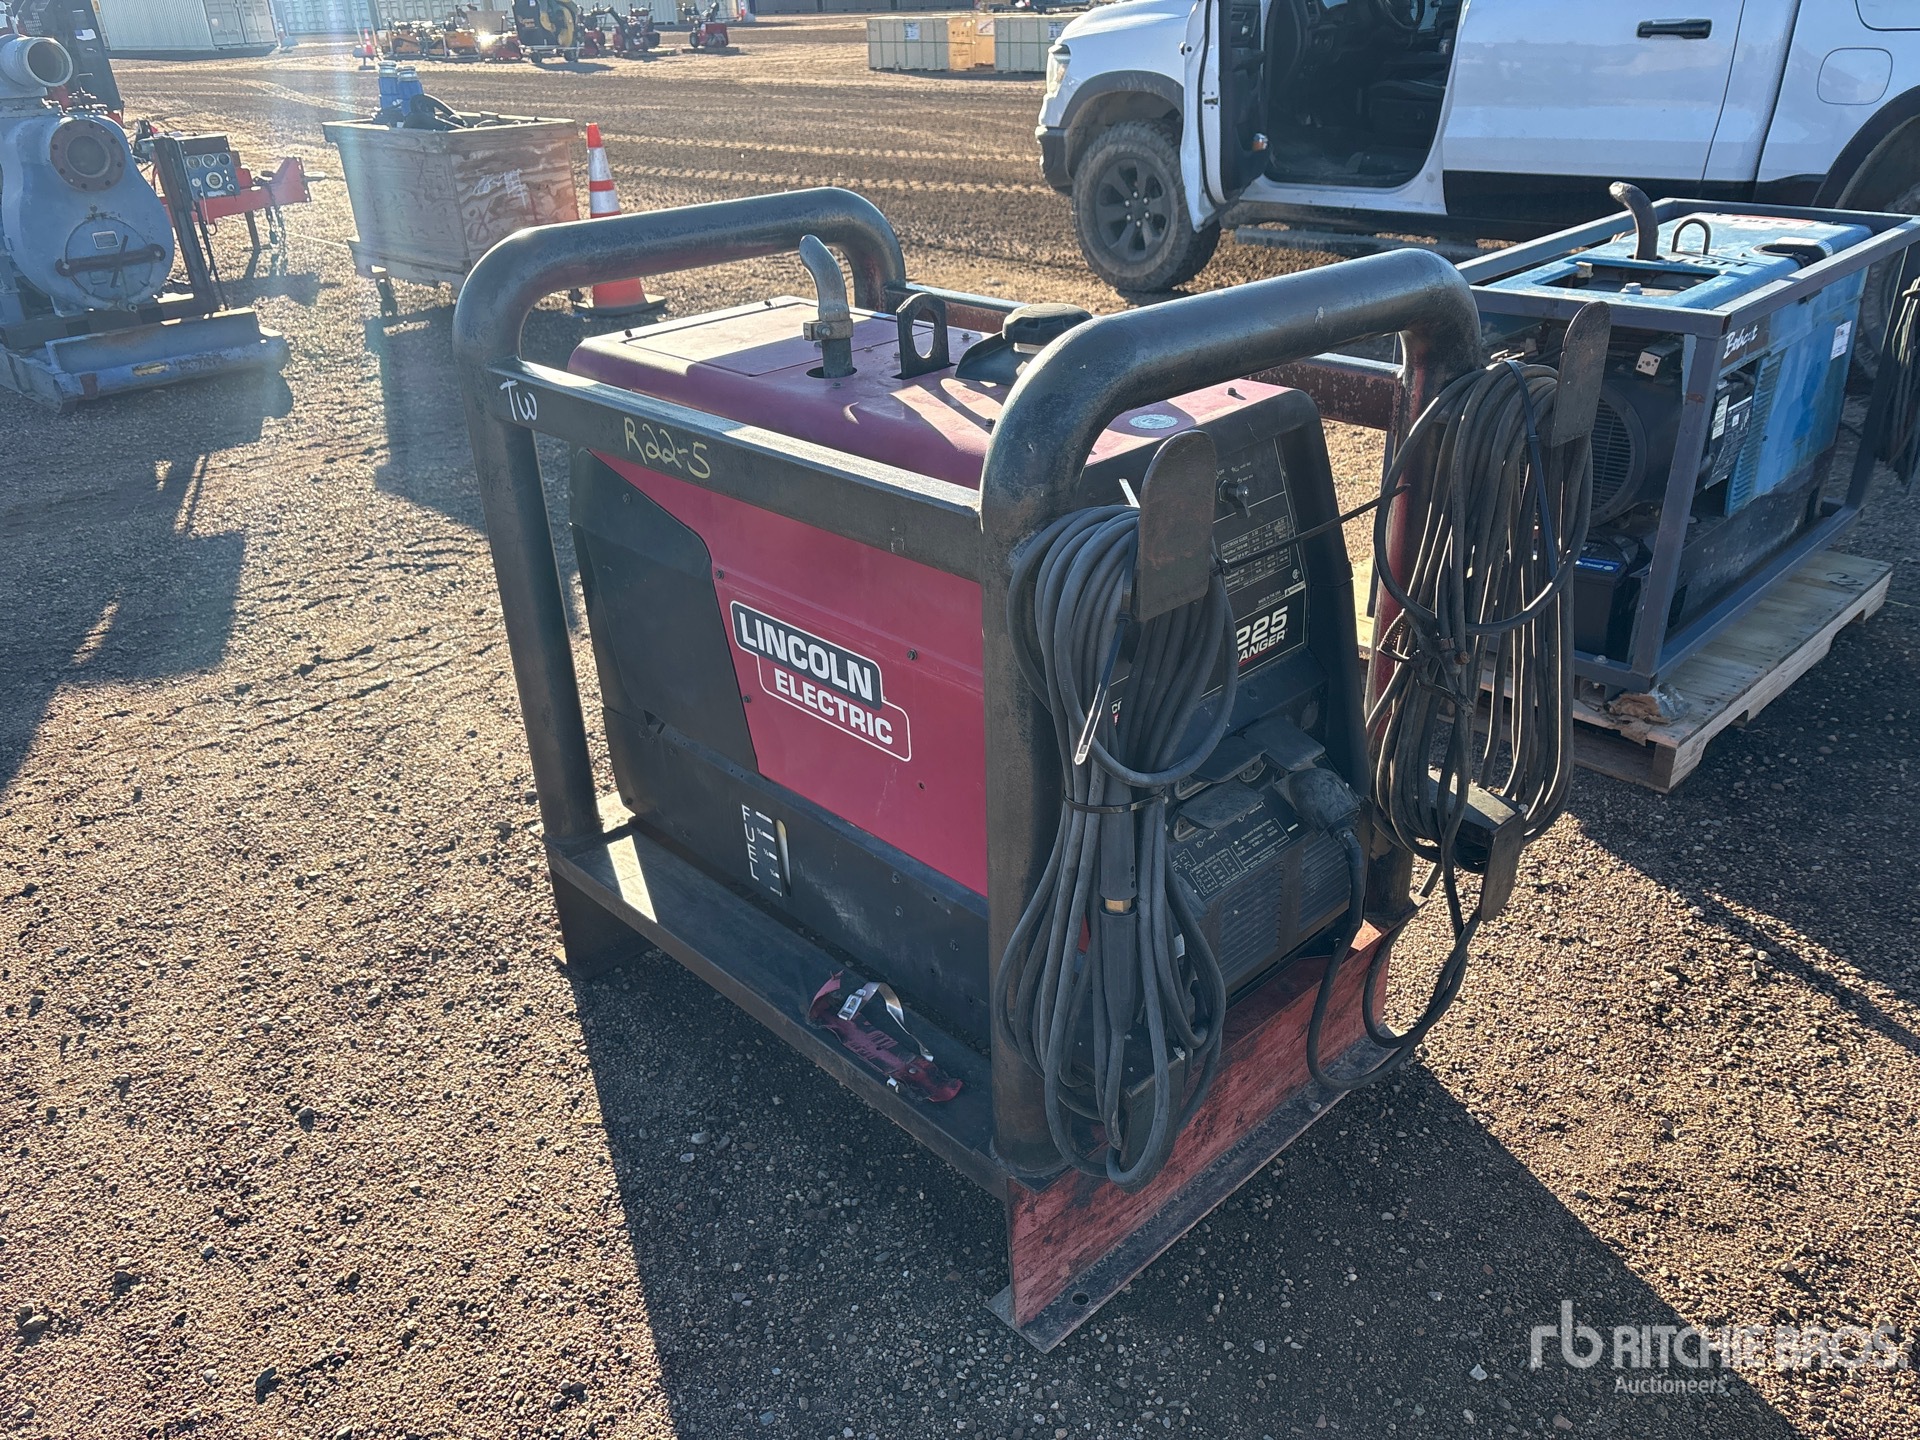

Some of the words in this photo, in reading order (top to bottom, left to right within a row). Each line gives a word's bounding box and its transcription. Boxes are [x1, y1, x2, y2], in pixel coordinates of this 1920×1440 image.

[623, 416, 711, 479] R22-5
[738, 612, 874, 702] LINCOLN
[1236, 605, 1288, 651] 225
[1237, 629, 1287, 663] ANGER
[774, 667, 893, 746] ELECTRIC
